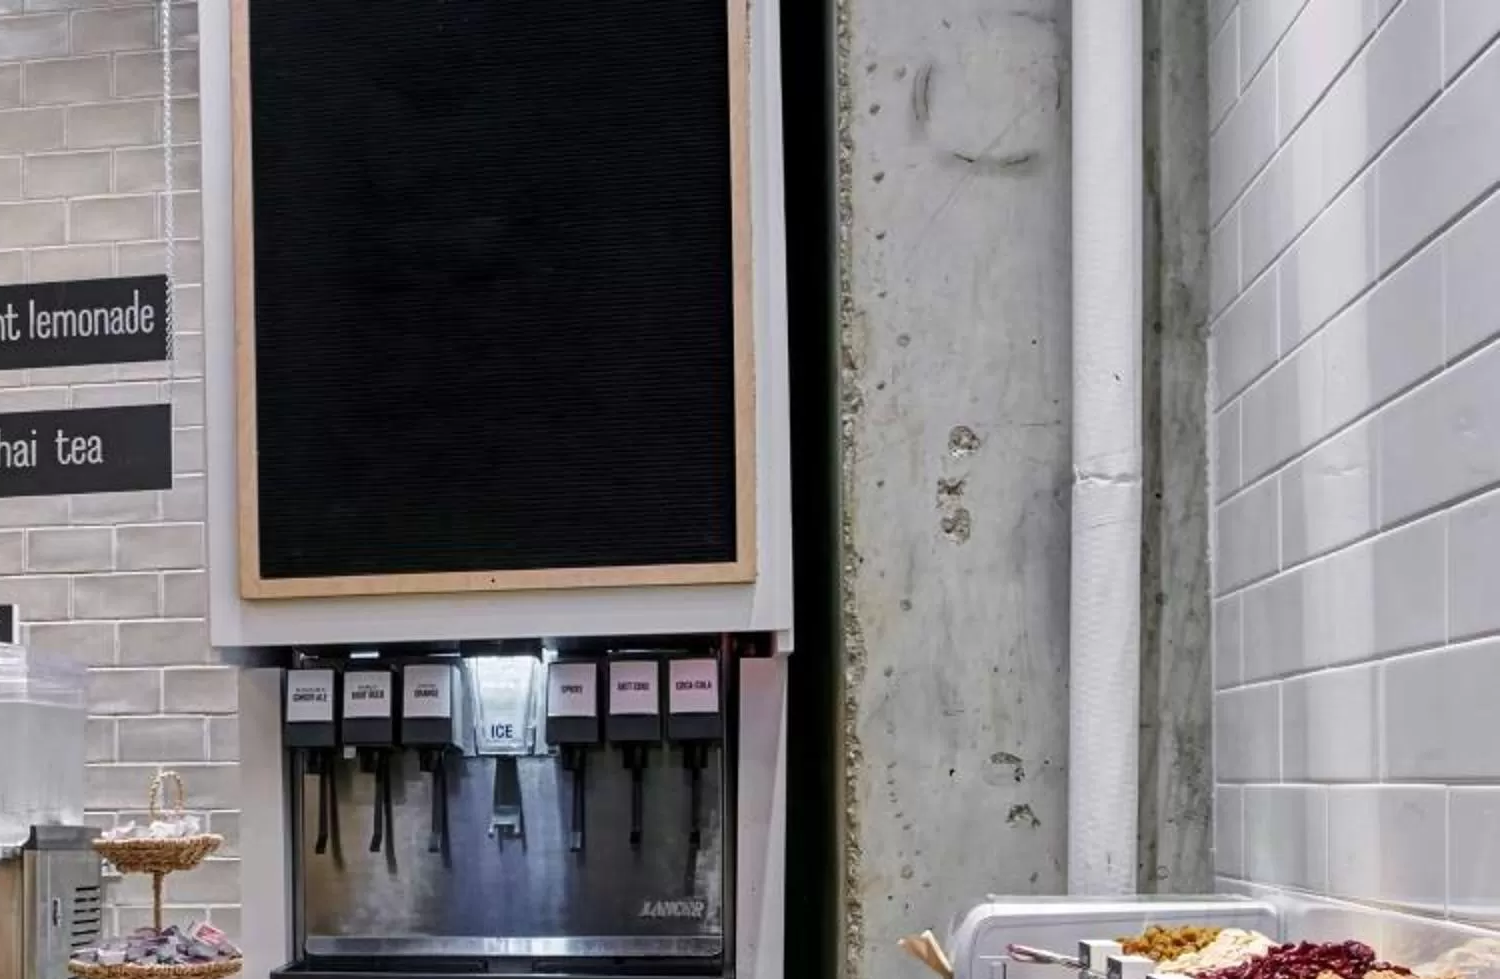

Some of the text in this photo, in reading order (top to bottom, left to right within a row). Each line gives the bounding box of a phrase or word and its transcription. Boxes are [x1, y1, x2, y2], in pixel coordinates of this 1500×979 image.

[29, 288, 156, 339] lemonade
[54, 428, 105, 466] tea
[491, 723, 514, 739] ICE
